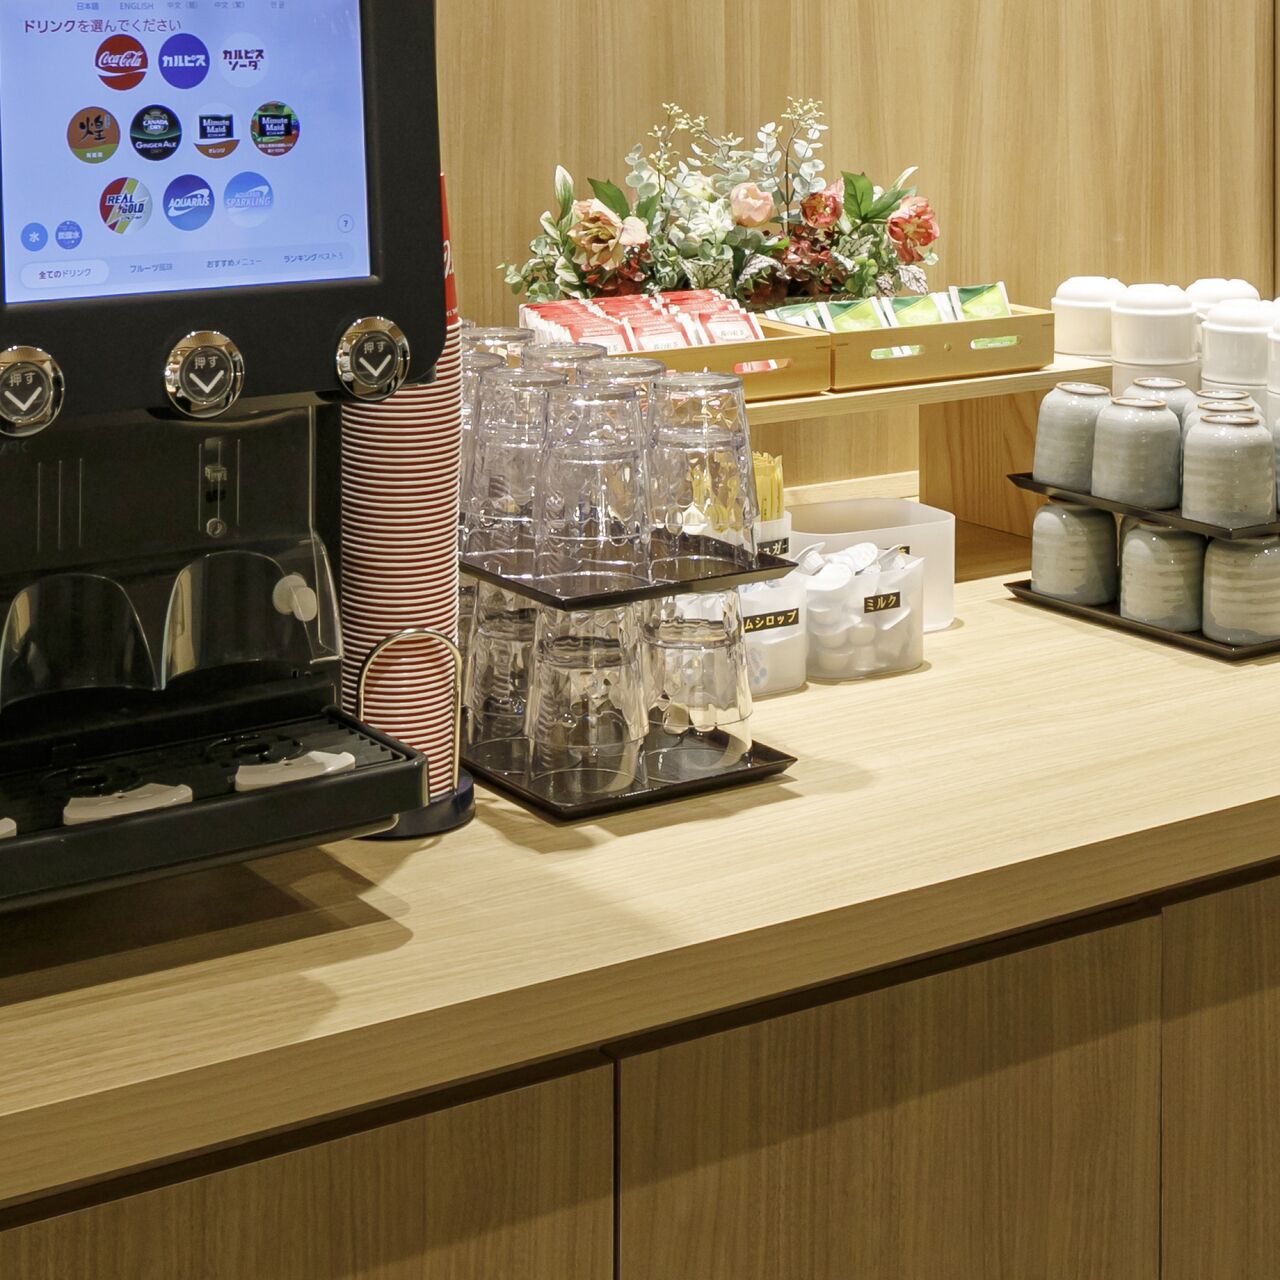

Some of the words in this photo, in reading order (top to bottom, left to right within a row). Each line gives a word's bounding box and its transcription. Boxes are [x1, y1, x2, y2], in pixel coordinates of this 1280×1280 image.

[76, 2, 99, 11] 日本語
[120, 2, 154, 10] ENGLISH
[24, 19, 182, 33] ドリンクを選んでください
[222, 49, 264, 60] カルピス
[162, 55, 207, 67] カルピス
[228, 60, 260, 71] ソーダ
[143, 119, 169, 127] CANADA
[202, 118, 230, 126] Minute
[261, 117, 289, 125] Minute
[79, 114, 106, 142] 煌
[207, 125, 226, 133] Maid
[265, 124, 285, 132] Maid
[107, 193, 135, 205] REAL
[168, 195, 210, 208] AQUARIUS
[225, 196, 272, 208] SPARKLING
[121, 203, 144, 214] GOLD
[28, 231, 40, 242] 水
[206, 258, 263, 268] おすすめメニュー
[39, 268, 92, 280] 全てのドリンク
[363, 341, 387, 354] 押す
[194, 356, 219, 369] 押す
[9, 372, 36, 387] 押す
[866, 594, 897, 611] ミルク
[744, 609, 798, 631] ムシロップ
